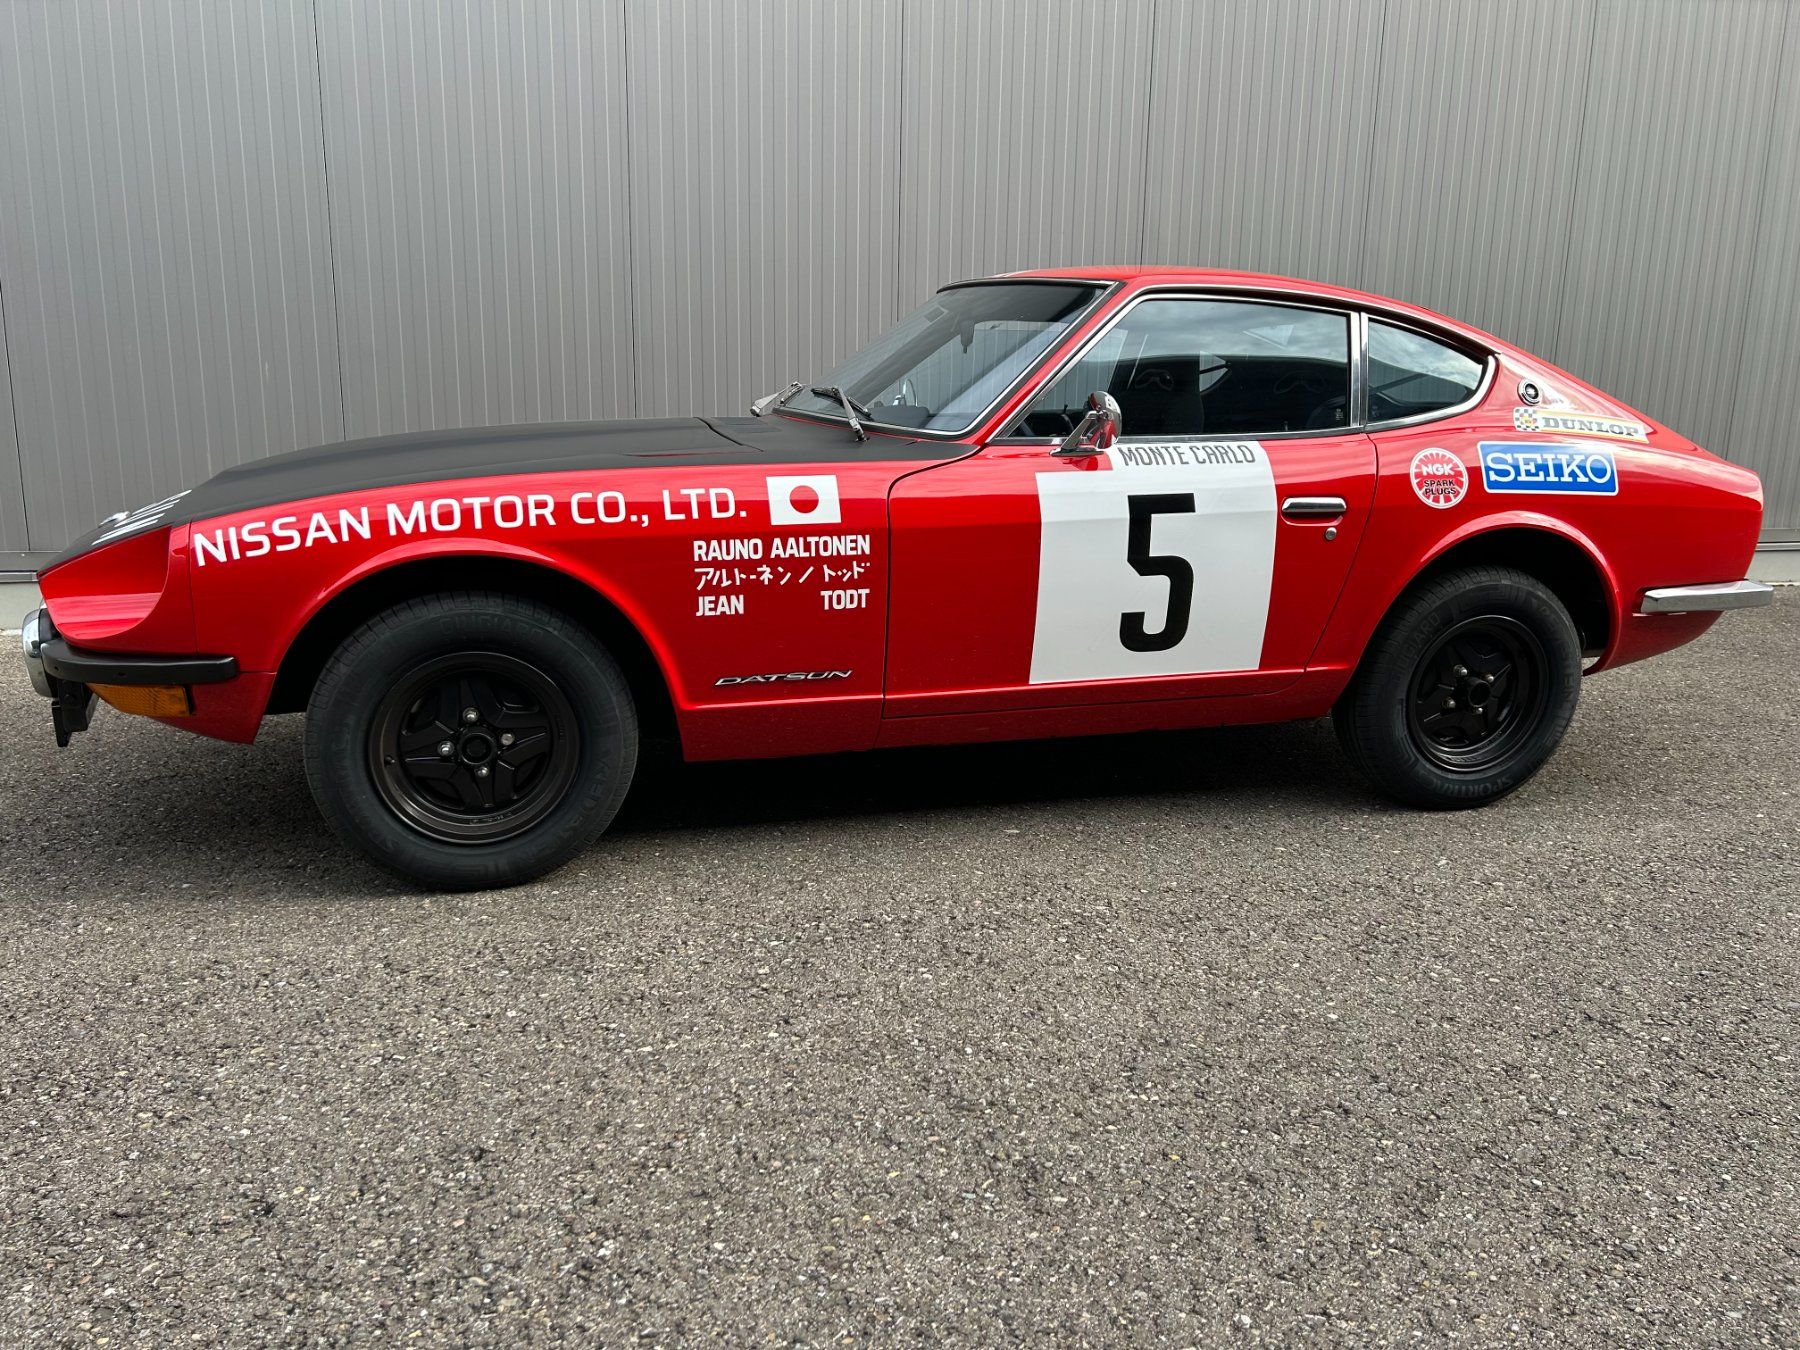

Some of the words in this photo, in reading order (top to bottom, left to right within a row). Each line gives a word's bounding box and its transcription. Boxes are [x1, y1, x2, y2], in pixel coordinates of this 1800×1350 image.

[1541, 415, 1640, 438] DUNLOP
[1117, 447, 1190, 467] MONTE
[1189, 445, 1256, 464] CARLO
[1486, 451, 1612, 484] SEIKO
[1420, 462, 1455, 477] NGK
[1423, 478, 1456, 488] SPARK
[1424, 487, 1457, 496] PLUGS
[193, 506, 372, 568] NISSAN
[386, 494, 558, 537] MOTOR
[570, 490, 650, 528] CO.,
[661, 487, 748, 521] LTD.
[692, 537, 764, 562] RAUNO
[769, 534, 871, 559] AALTONEN
[1119, 493, 1196, 652] 5
[695, 594, 745, 617] JEAN
[820, 588, 871, 611] TODT
[714, 669, 853, 686] DATSUN
